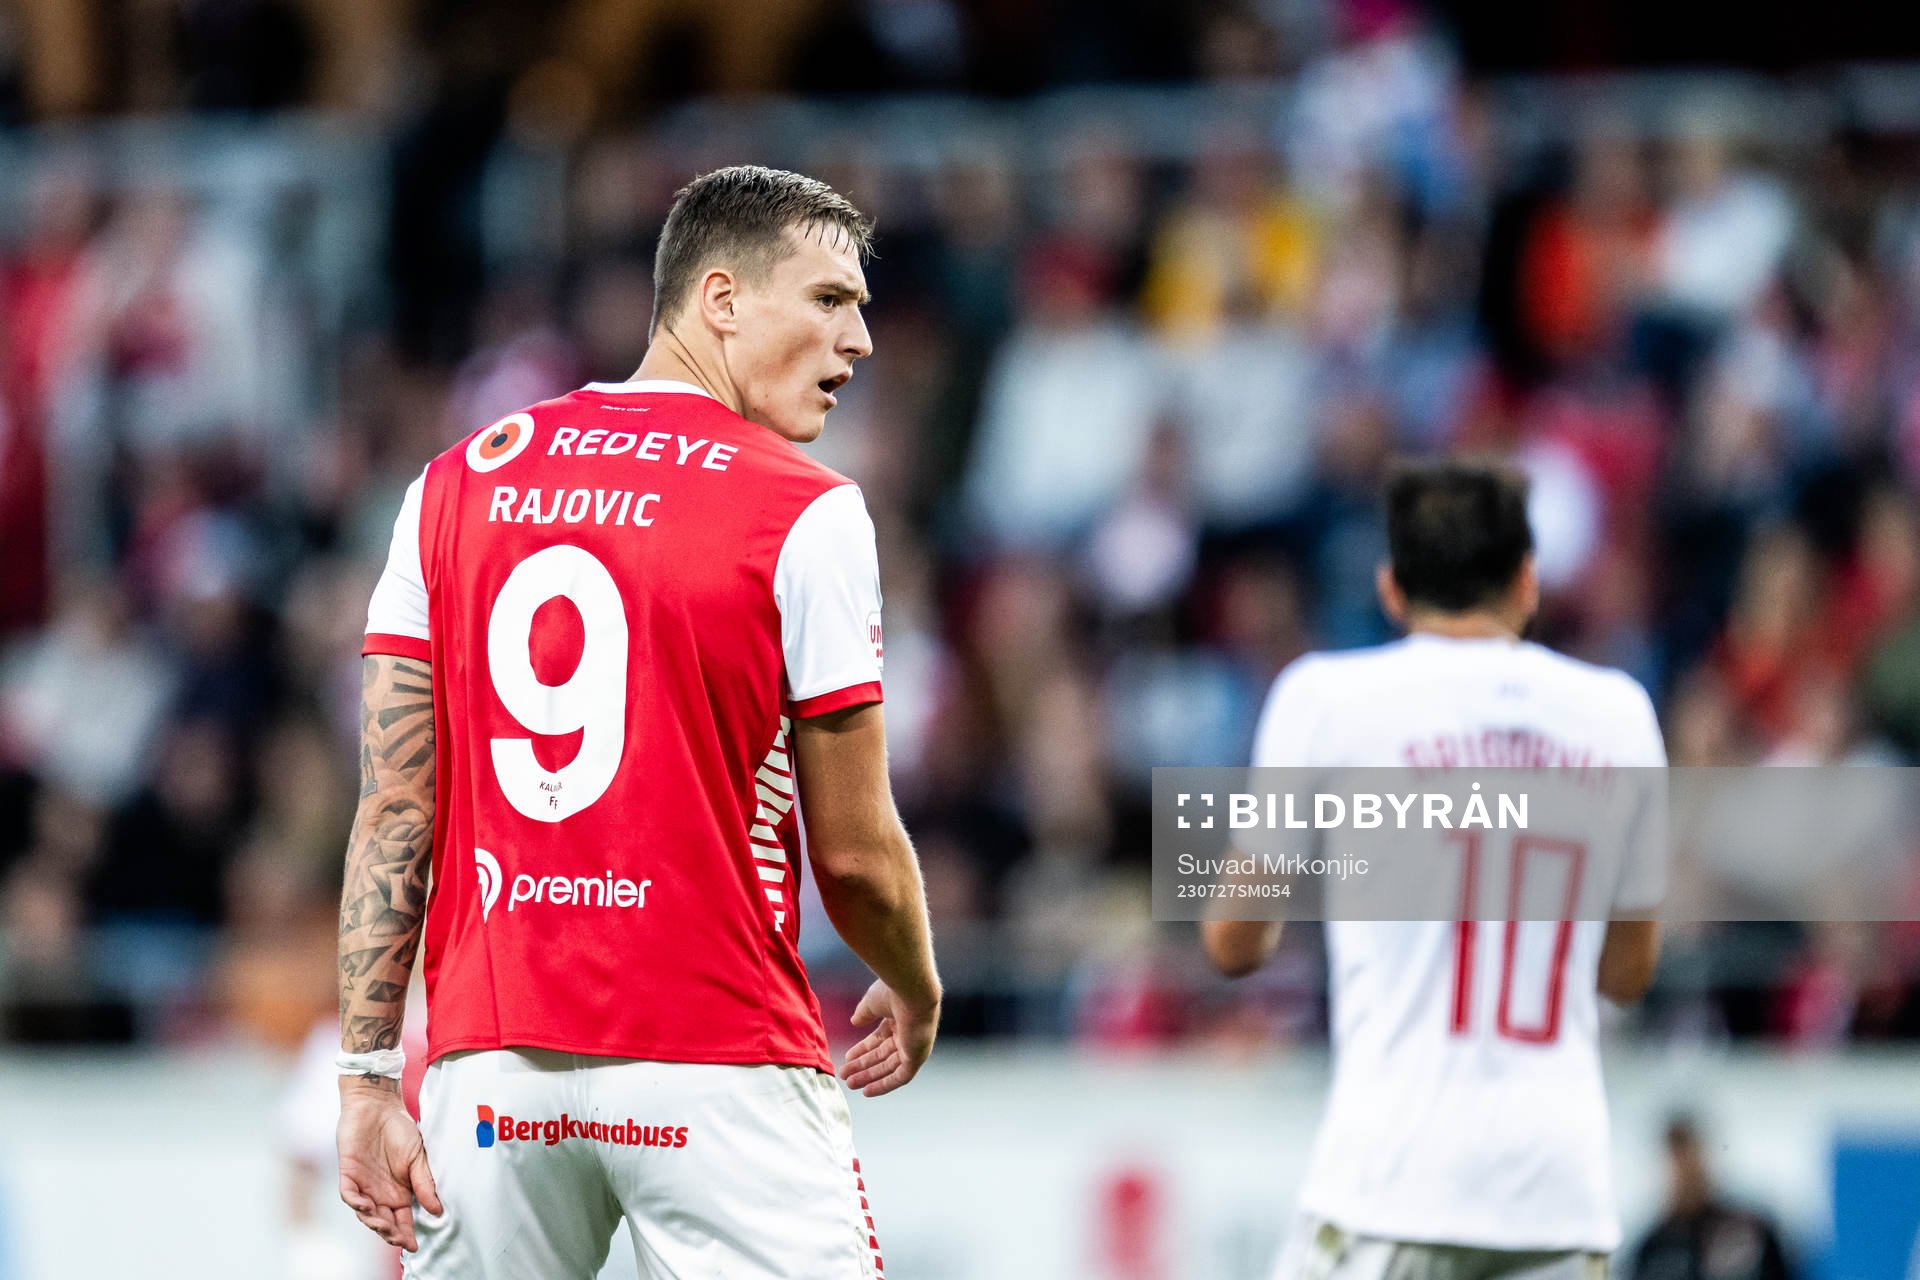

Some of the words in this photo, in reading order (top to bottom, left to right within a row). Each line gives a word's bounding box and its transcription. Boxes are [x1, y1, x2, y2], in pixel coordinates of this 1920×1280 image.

[546, 426, 739, 472] REDEYE
[488, 485, 661, 527] RAJOVIC
[488, 544, 629, 823] 9
[507, 870, 652, 912] premier
[1440, 827, 1588, 1046] 10
[498, 1113, 689, 1149] Bergkvarabuss
